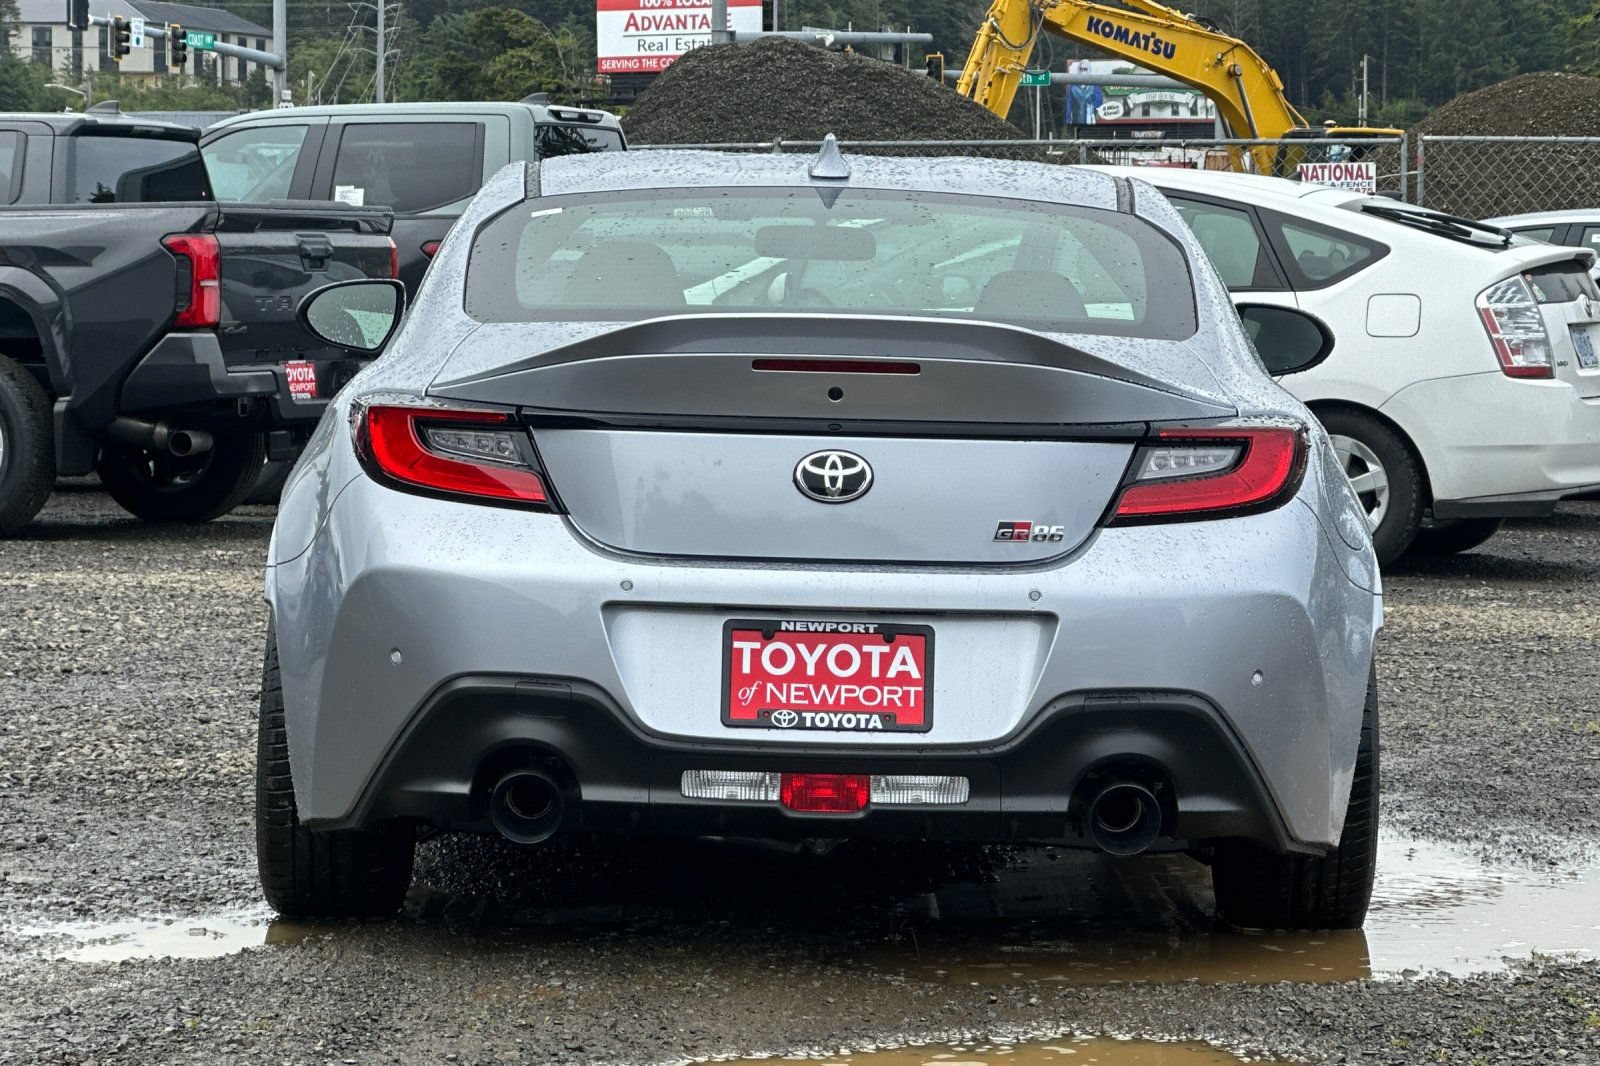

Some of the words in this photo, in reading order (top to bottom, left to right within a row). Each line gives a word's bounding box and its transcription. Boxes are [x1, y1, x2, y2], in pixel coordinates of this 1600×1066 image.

[624, 12, 732, 32] ADVANTAE
[188, 33, 203, 46] COAST
[637, 38, 669, 52] Real
[675, 38, 712, 51] Estat
[1087, 16, 1176, 60] KOMATSU
[601, 59, 640, 70] SERVING
[642, 59, 658, 68] THE
[1299, 163, 1374, 181] NATIONAL
[286, 368, 315, 381] OYOTA
[996, 528, 1030, 540] GR
[1032, 525, 1064, 541] 86
[781, 621, 879, 634] NEWPORT
[733, 641, 922, 679] TOYOTA
[738, 680, 762, 706] of
[765, 682, 923, 708] NEWPORT
[802, 712, 883, 729] TOYOTA
